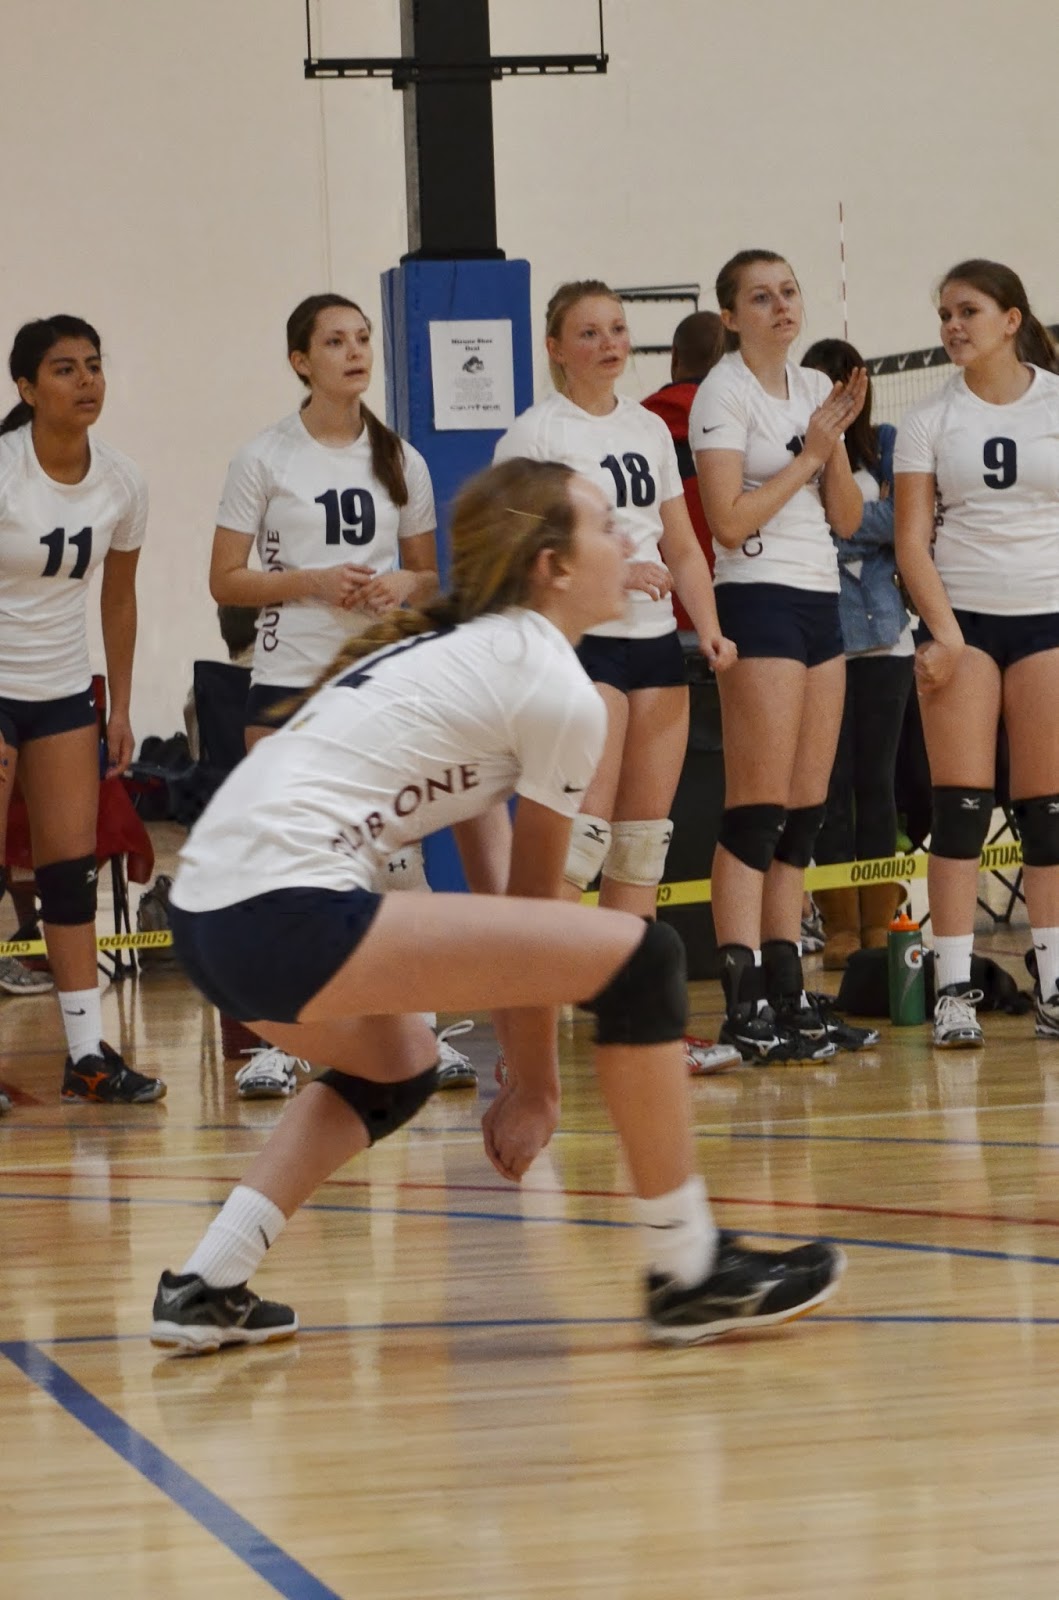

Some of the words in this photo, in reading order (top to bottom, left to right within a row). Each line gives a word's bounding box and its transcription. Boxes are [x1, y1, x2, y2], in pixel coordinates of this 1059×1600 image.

[599, 452, 656, 508] 18
[983, 436, 1017, 490] 9
[314, 487, 376, 546] 19
[39, 526, 92, 580] 11
[394, 763, 481, 817] ONE
